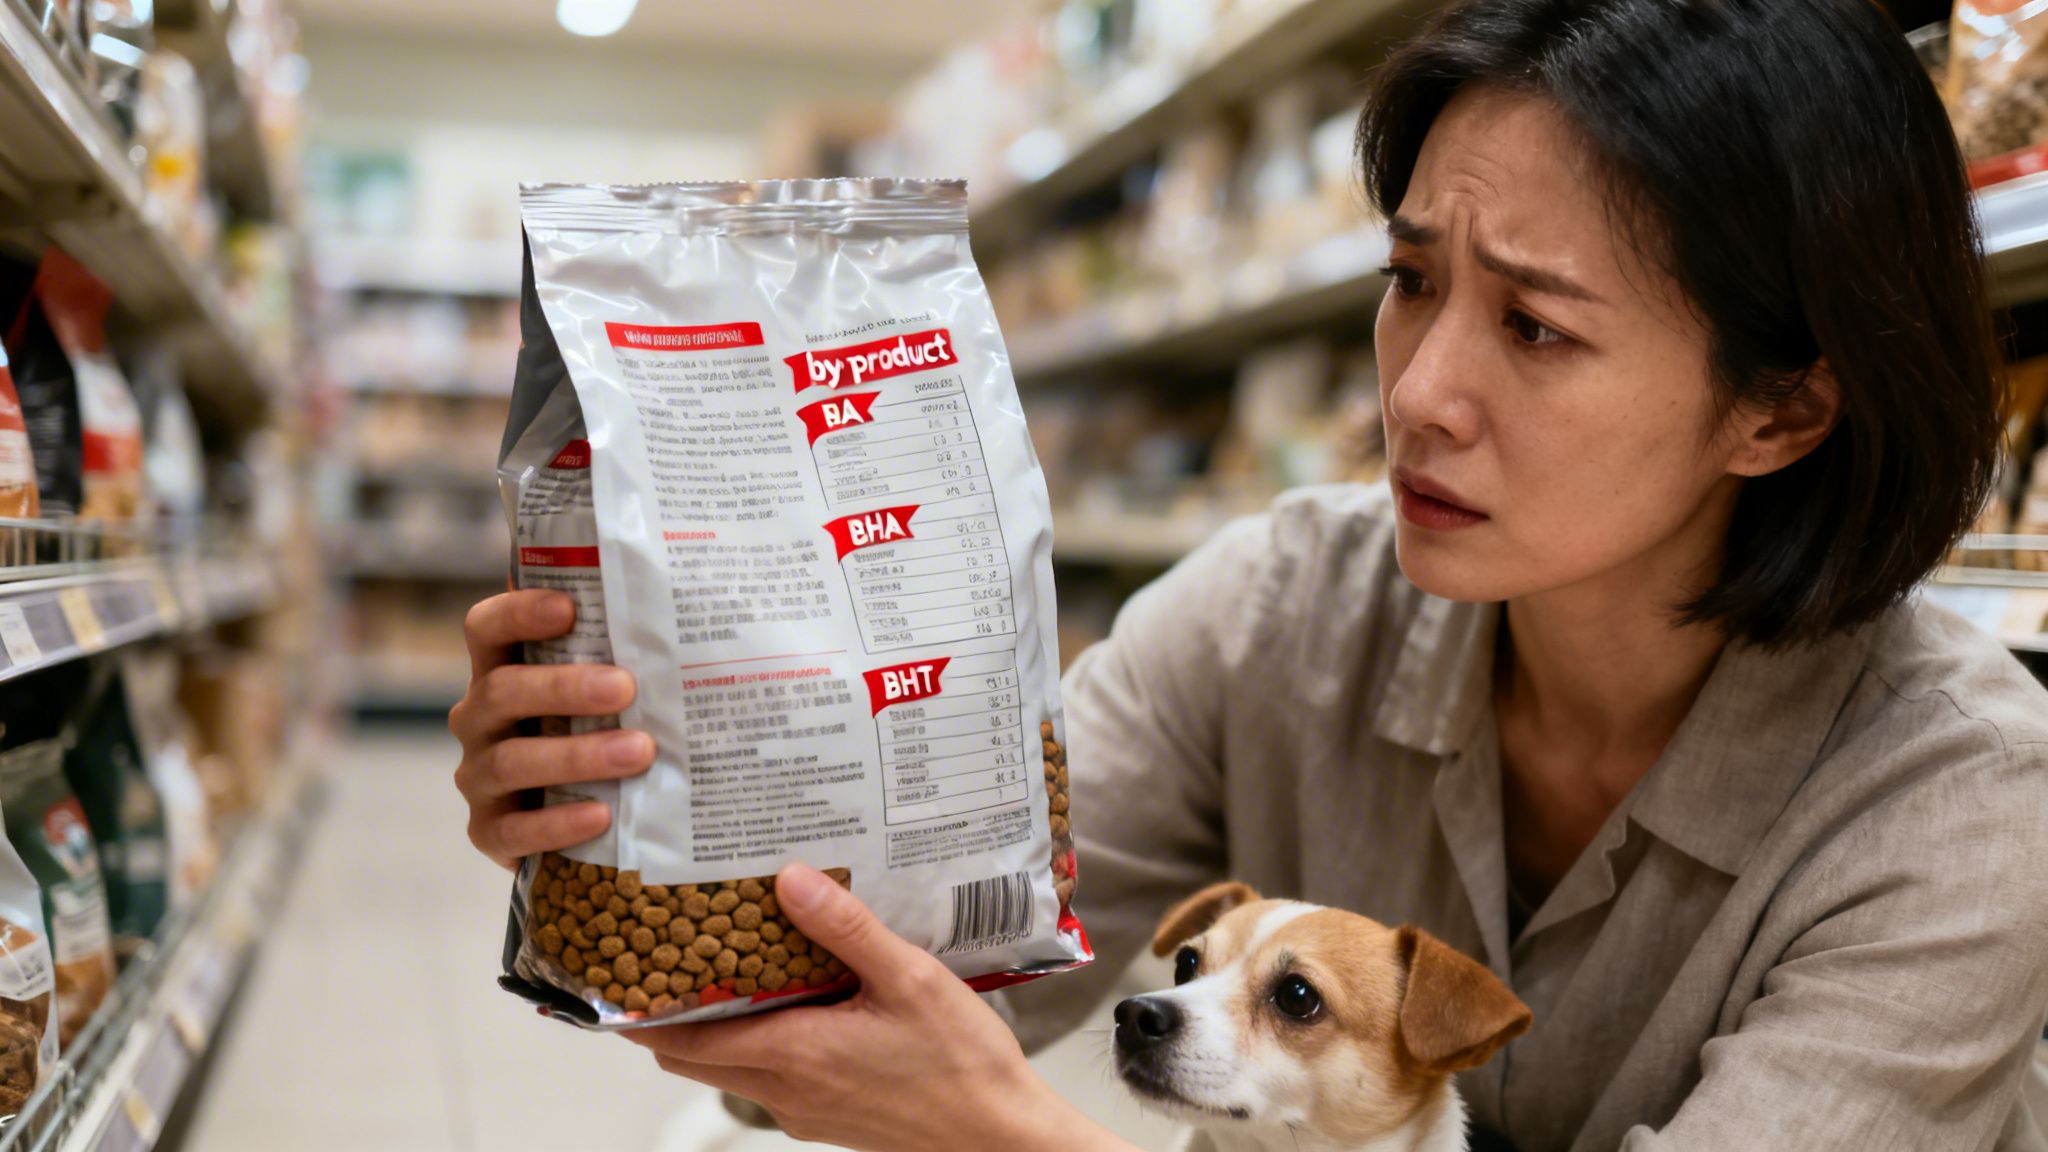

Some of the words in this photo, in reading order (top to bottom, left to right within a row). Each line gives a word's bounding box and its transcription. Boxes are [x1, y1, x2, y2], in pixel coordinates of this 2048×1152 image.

[806, 351, 844, 389] by
[846, 332, 950, 384] product
[847, 512, 906, 546] BHA
[881, 664, 933, 700] BHT
